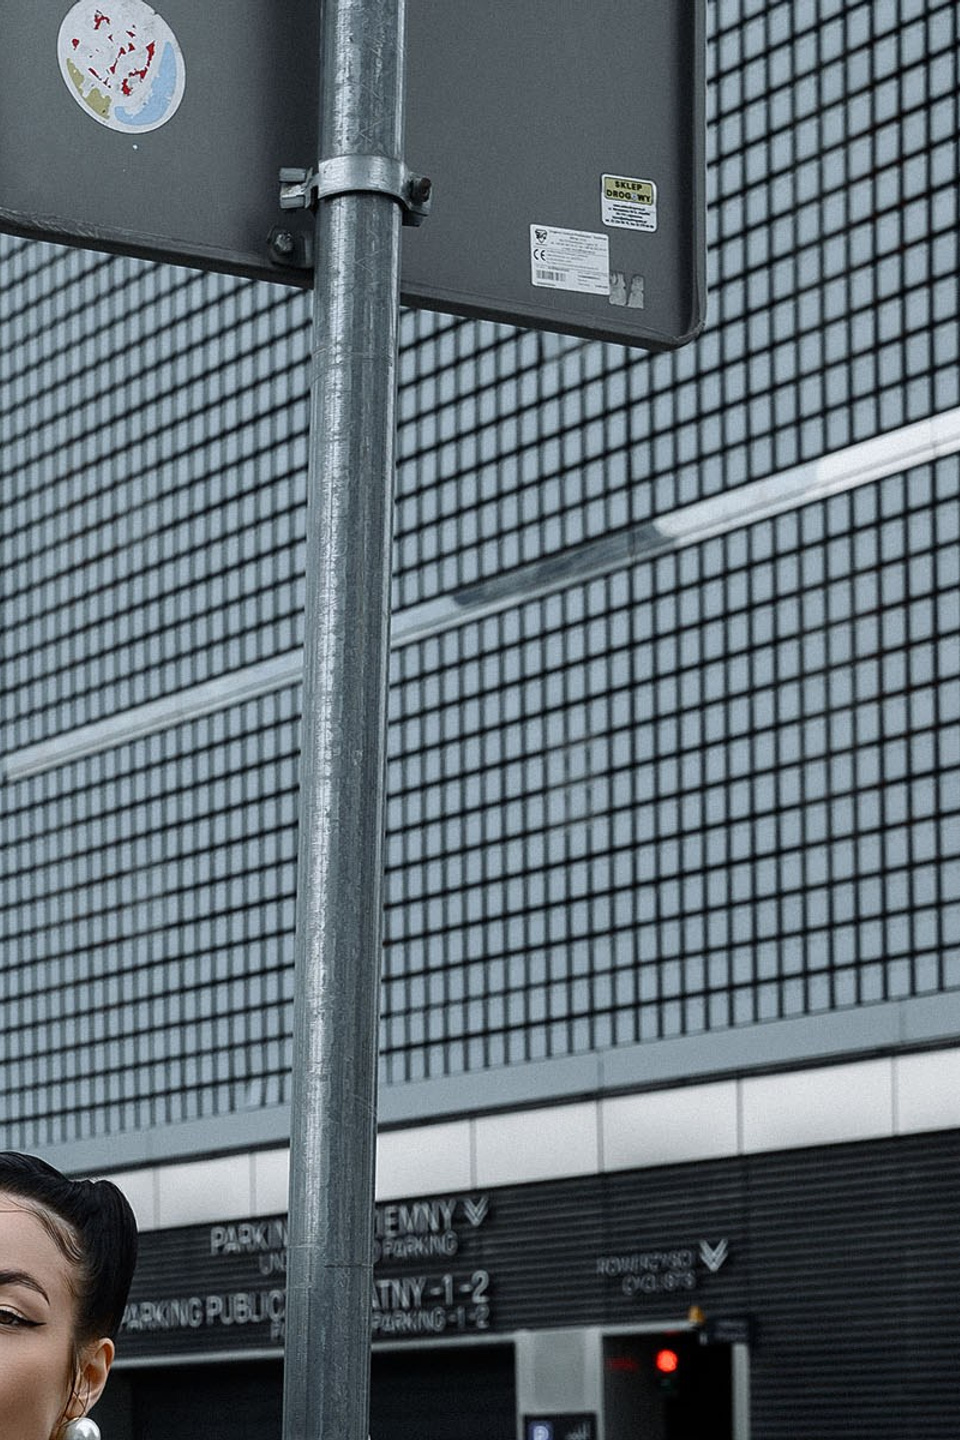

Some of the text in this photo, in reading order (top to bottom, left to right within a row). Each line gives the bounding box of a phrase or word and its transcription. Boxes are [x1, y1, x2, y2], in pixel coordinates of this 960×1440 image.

[615, 181, 643, 191] SKLEP
[210, 1198, 457, 1257] PARKIN IEMNY
[382, 1229, 458, 1258] PARKING
[120, 1297, 203, 1331] ARKING
[206, 1289, 285, 1326] PUBLIC
[372, 1306, 446, 1333] PARKING
